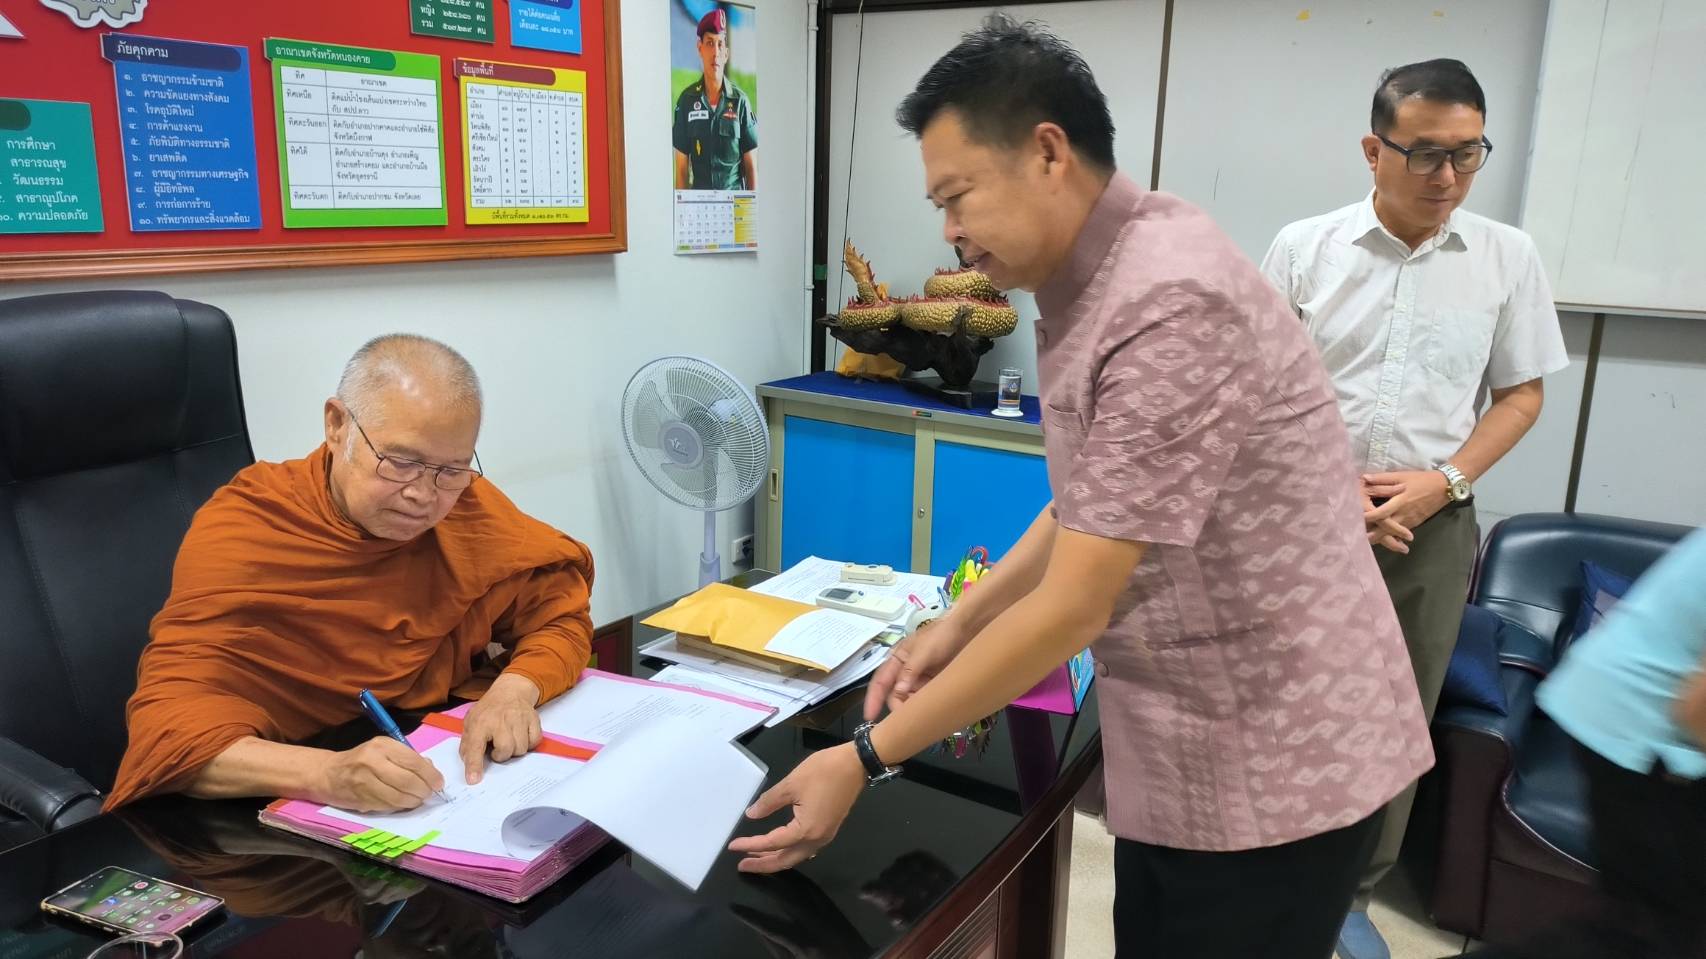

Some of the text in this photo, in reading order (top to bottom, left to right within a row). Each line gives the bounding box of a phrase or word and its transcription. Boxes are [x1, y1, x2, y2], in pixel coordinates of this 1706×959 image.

[476, 14, 486, 22] คน
[421, 20, 434, 29] รวม
[477, 27, 487, 35] คน
[117, 40, 169, 60] ภัยคุกคาม
[275, 46, 371, 63] อาณาเขตจังหวัดหนองคาย
[462, 62, 494, 78] ข้อมูลพื้นที่
[141, 73, 224, 88] อาชญากรรมข้ามชาติ
[147, 120, 203, 132] การค้าแรงงาน
[7, 136, 56, 150] การศึกษา
[149, 135, 230, 149] ภัยพิบัติทางธรรมชาติ
[10, 157, 67, 172] สาธารณสุข
[149, 152, 187, 163] ยาเสพติด
[13, 173, 64, 186] วัฒนธรรม
[152, 168, 249, 181] อาชญากรรมทางเศรษฐกิจ
[154, 181, 195, 197] ผู้มีอิทธิพล
[155, 197, 211, 209] การก่อการร้าย
[18, 208, 88, 221] ความปลอดภัย
[156, 210, 250, 224] ทรัพยากรและสิ่งแวดล้อม
